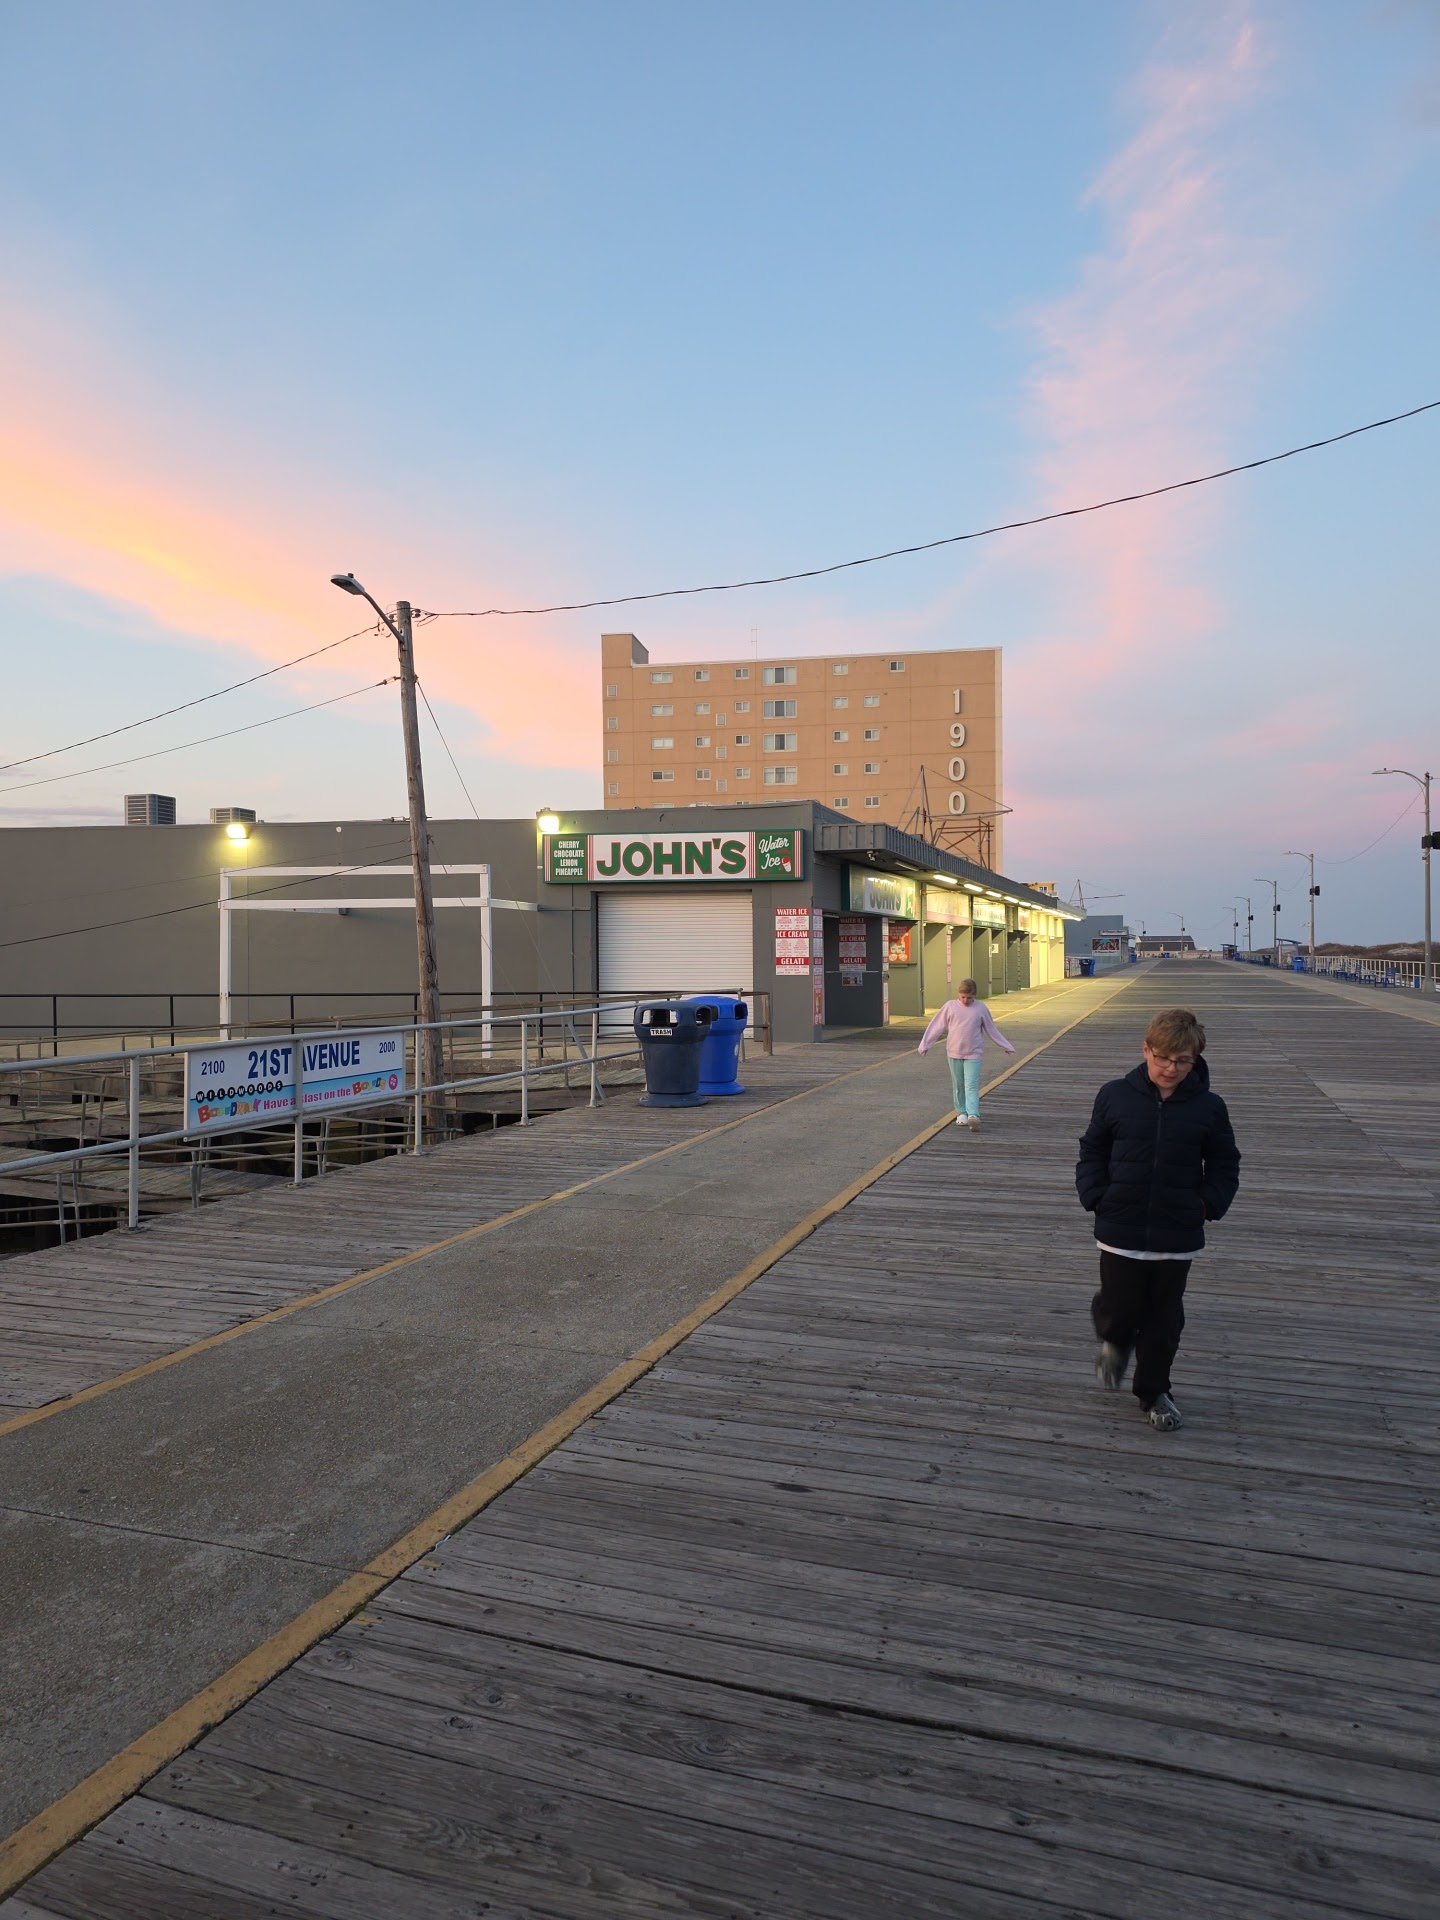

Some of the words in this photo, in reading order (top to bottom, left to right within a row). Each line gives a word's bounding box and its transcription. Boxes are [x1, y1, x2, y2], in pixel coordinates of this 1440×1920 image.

[948, 688, 966, 815] 1900
[558, 840, 580, 849] CHERRY
[758, 835, 790, 854] Water
[553, 849, 585, 858] CHOCOLATE
[596, 837, 747, 876] JOHN'S
[560, 858, 578, 867] LEMON
[760, 854, 781, 869] Ice
[555, 867, 583, 876] PINEAPPLE
[776, 908, 797, 916] WATER
[798, 908, 808, 916] ICE
[777, 930, 787, 938] ICE
[787, 930, 808, 938] CREAM
[780, 957, 805, 965] GELATI
[378, 1040, 396, 1054] 2000
[201, 1059, 225, 1076] 2100
[247, 1047, 292, 1079] 21ST
[195, 1080, 283, 1103] WILDWOODS
[263, 1098, 289, 1110] Have
[290, 1097, 297, 1106] a
[302, 1092, 322, 1103] last
[324, 1090, 335, 1100] on
[337, 1087, 351, 1098] the
